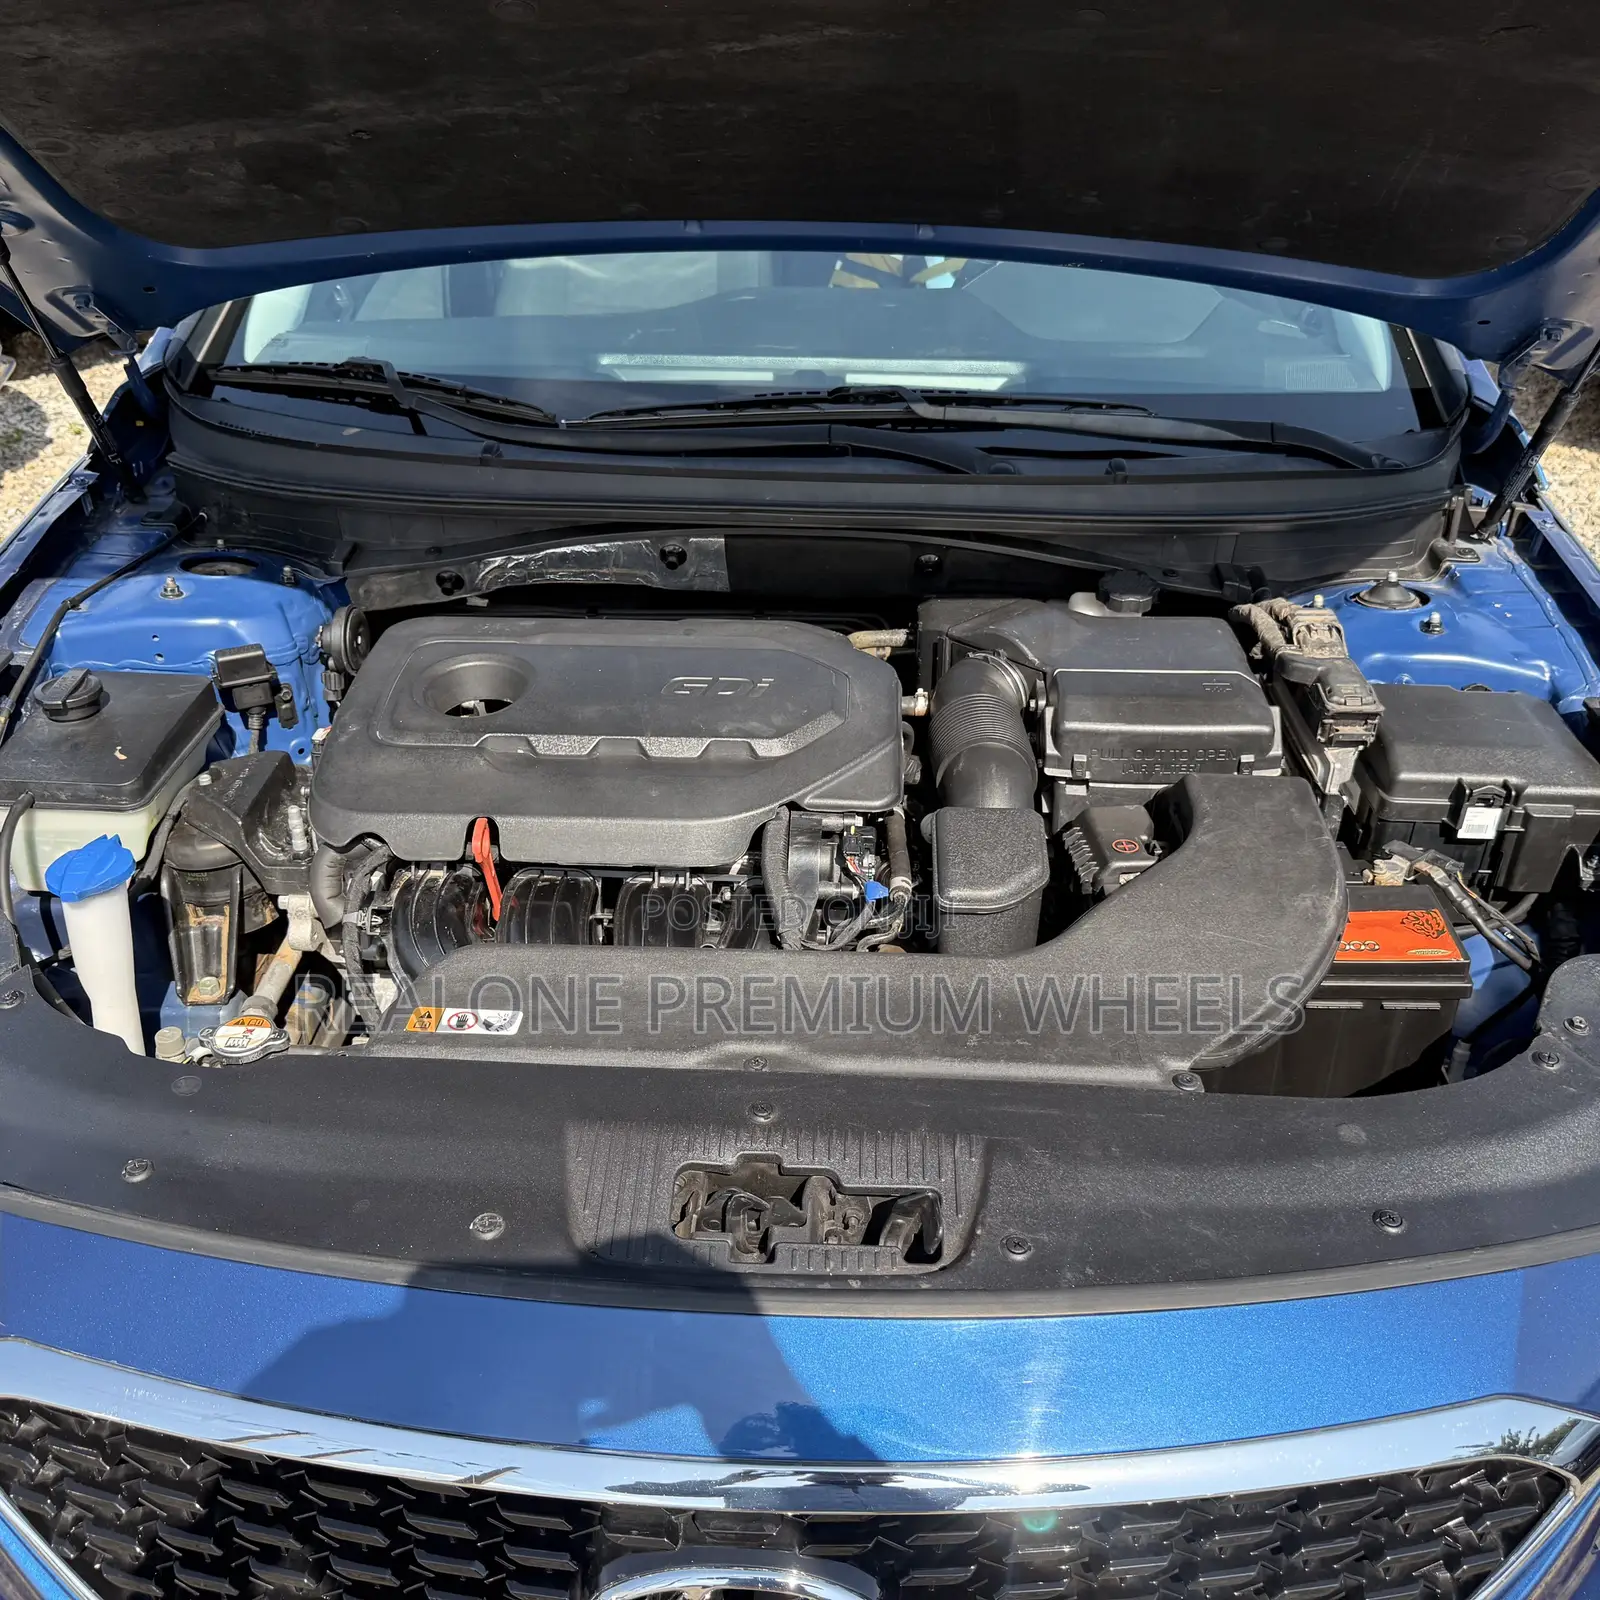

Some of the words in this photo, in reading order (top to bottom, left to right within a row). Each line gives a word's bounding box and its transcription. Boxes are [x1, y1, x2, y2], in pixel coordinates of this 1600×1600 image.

[1089, 749, 1128, 761] PULL
[1132, 749, 1165, 761] OUT
[1169, 749, 1189, 761] TO
[1194, 749, 1237, 761] OPEN
